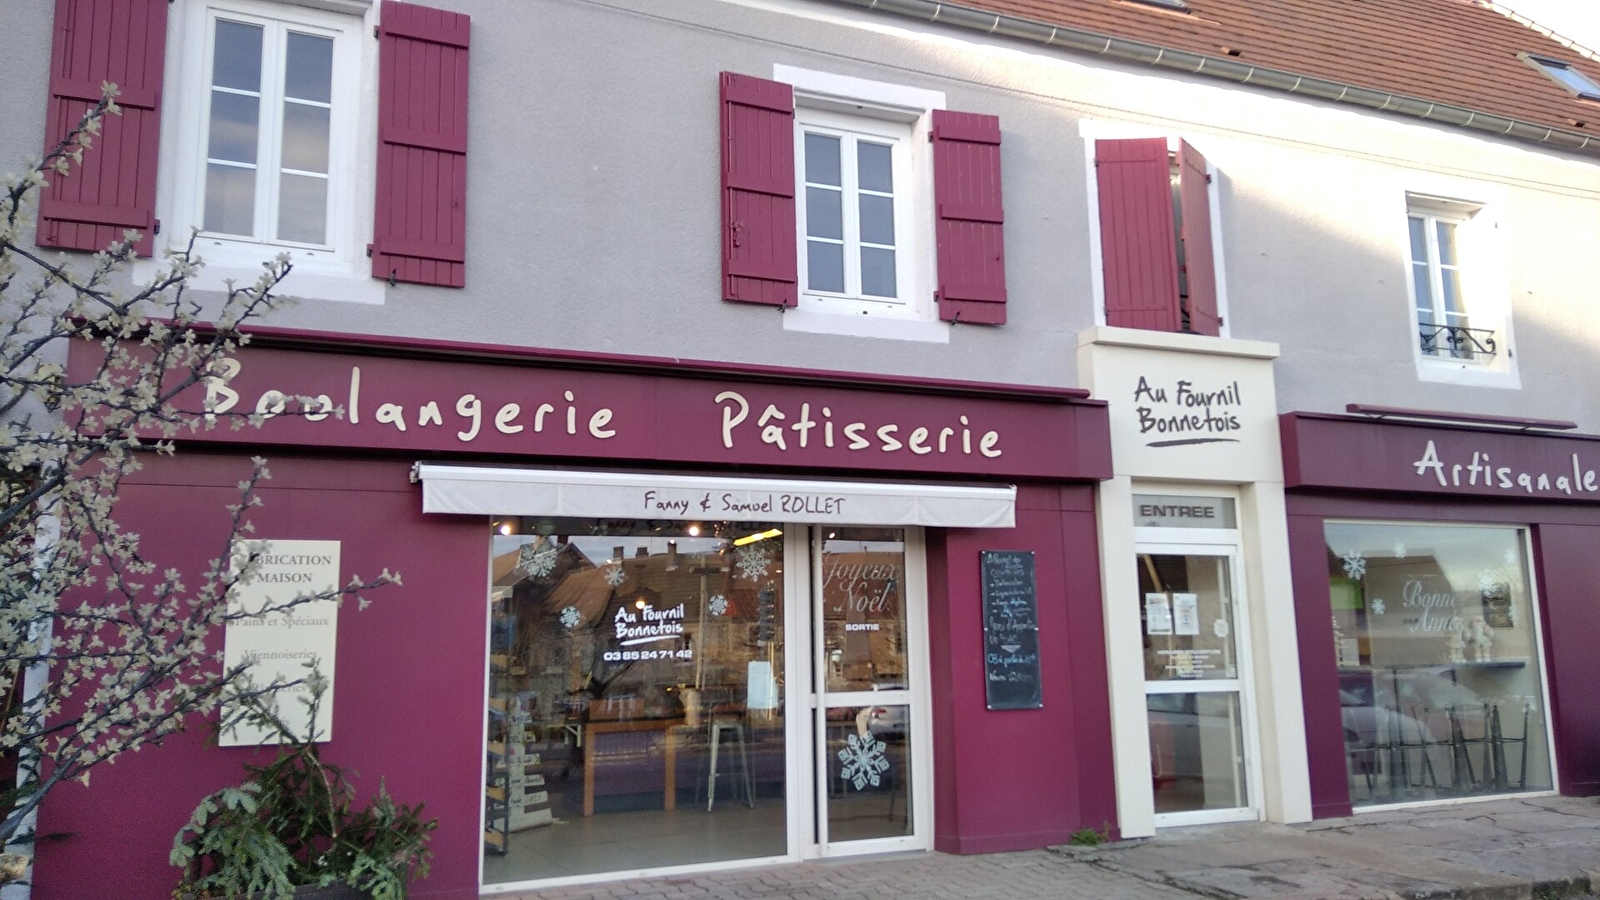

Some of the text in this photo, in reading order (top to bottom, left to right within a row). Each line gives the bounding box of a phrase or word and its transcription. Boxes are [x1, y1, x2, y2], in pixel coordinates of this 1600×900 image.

[1134, 376, 1241, 407] Au Fournil
[205, 357, 1002, 458] Boulangerie Pâtisserie
[1136, 406, 1241, 433] Bonnetois
[1413, 440, 1599, 495] Artisanale
[644, 491, 689, 515] Fanny
[722, 493, 773, 513] Samuel
[780, 494, 846, 514] ROLLET
[1140, 504, 1216, 518] ENTREE
[242, 554, 332, 566] BRICATION
[257, 572, 313, 583] MAISON
[823, 552, 895, 592] Joyeux
[834, 581, 892, 612] Noël
[268, 618, 278, 627] et
[282, 615, 329, 629] Spéciaux
[615, 603, 684, 623] Au Fournil
[615, 621, 683, 638] Bonnetois
[845, 623, 880, 631] SORTIE
